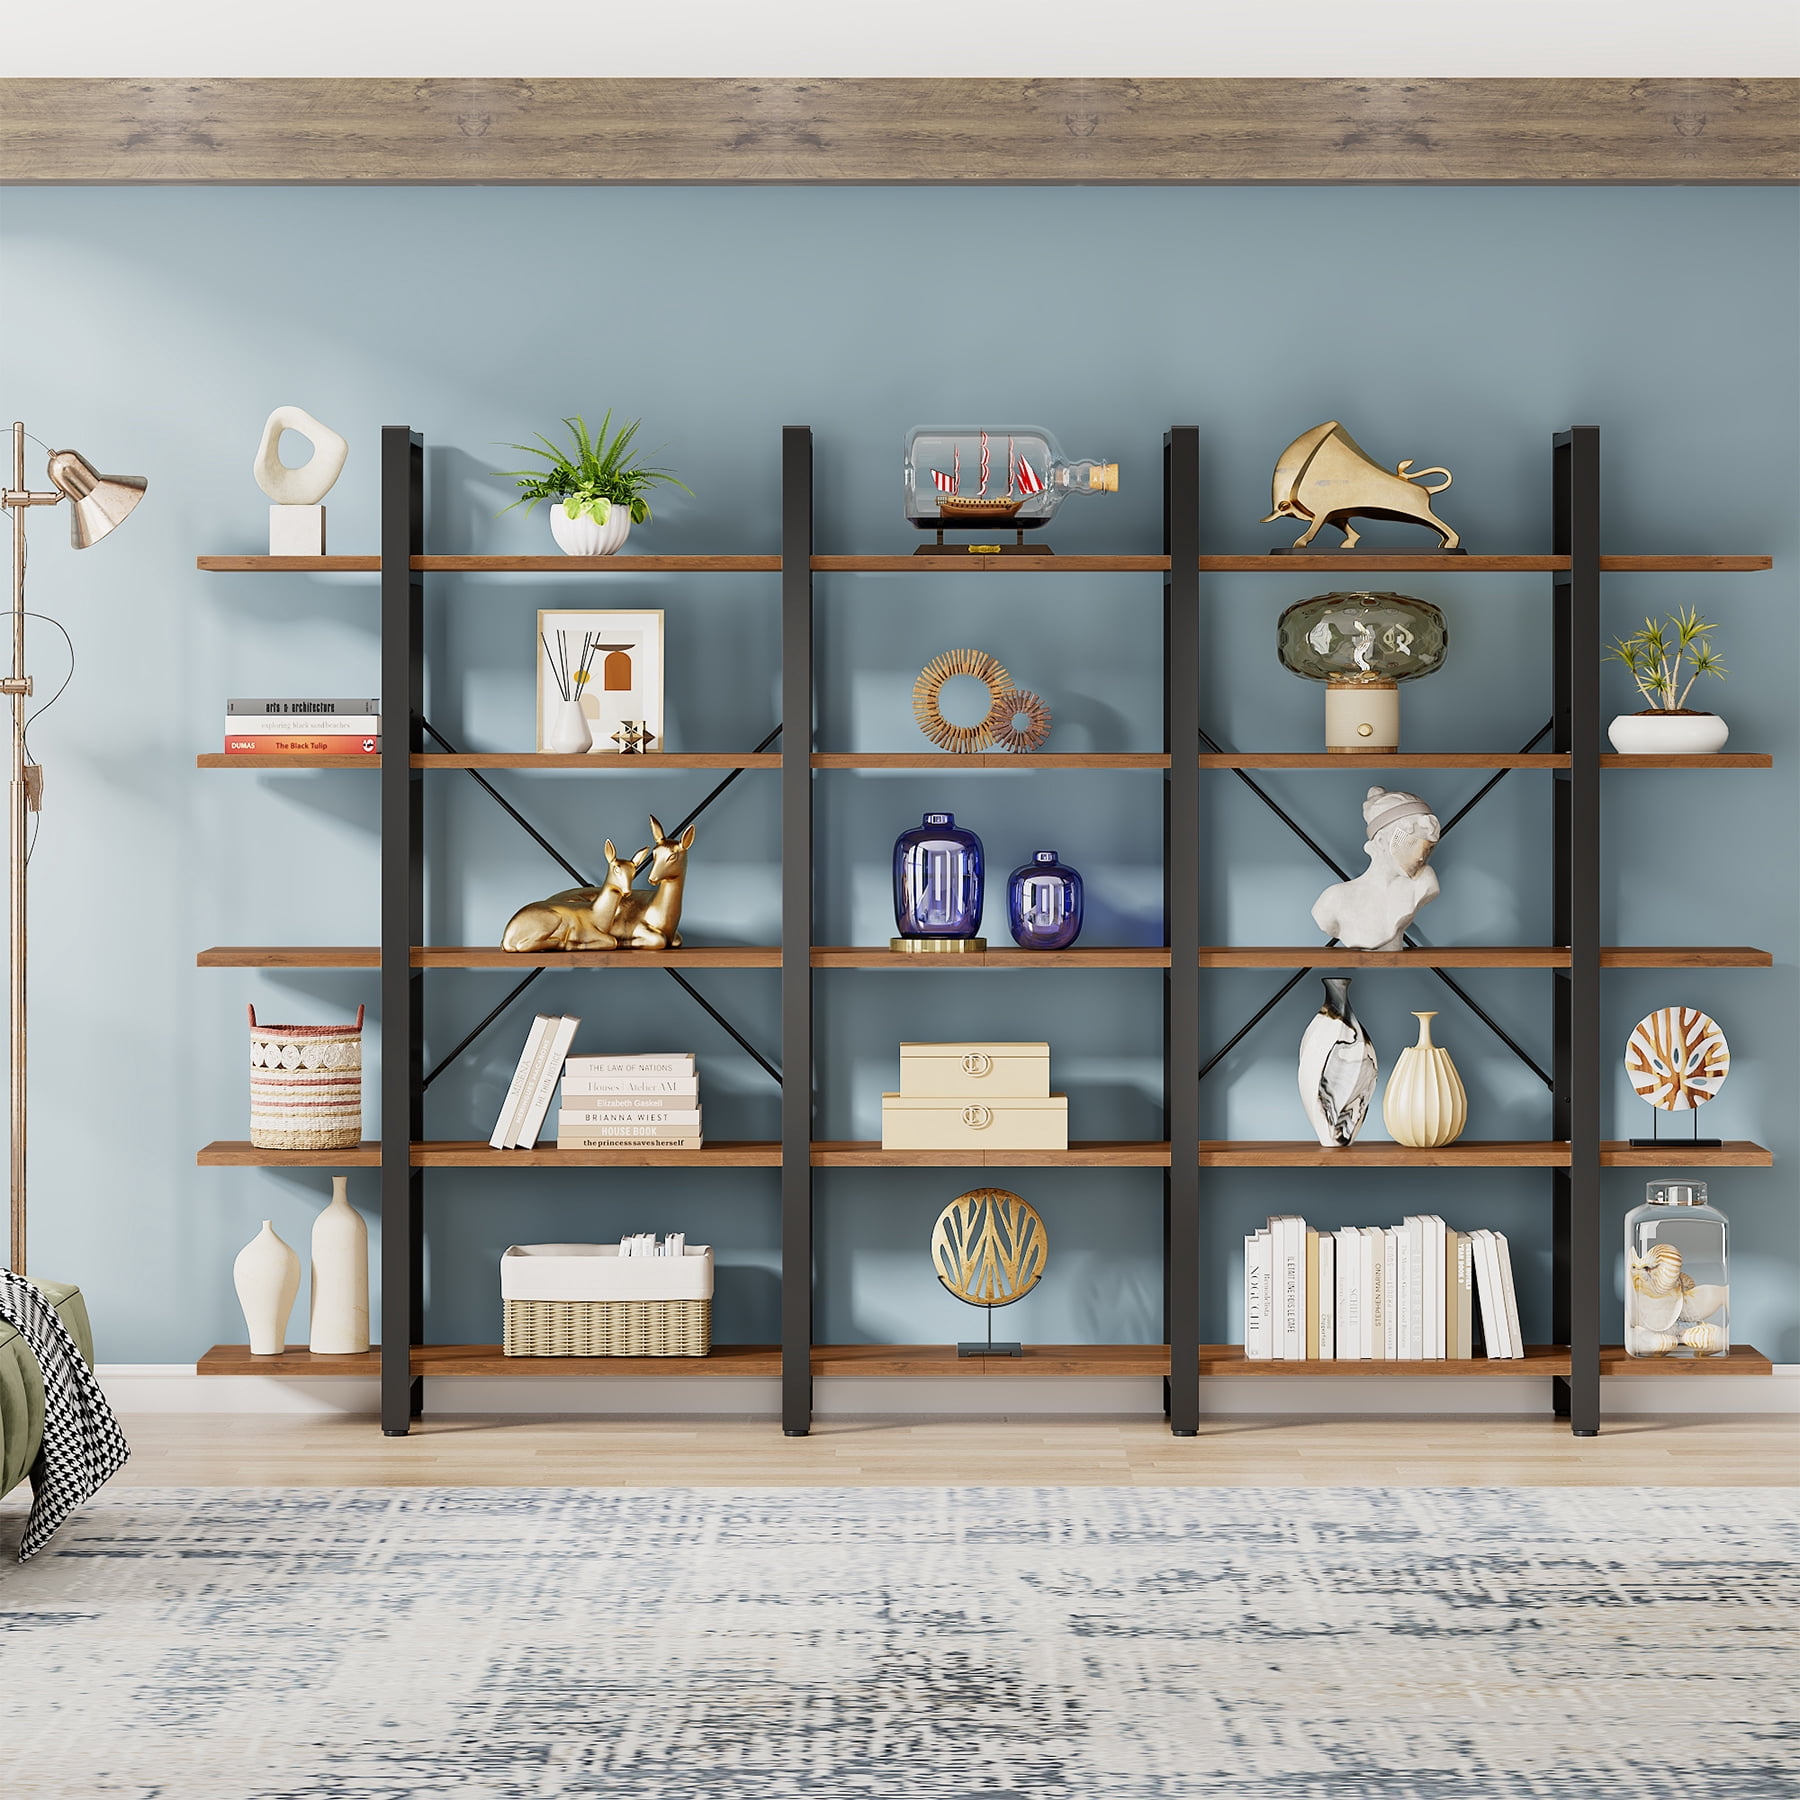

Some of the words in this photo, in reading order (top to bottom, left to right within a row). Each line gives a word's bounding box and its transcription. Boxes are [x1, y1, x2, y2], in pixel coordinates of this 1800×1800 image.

[266, 702, 280, 713] arts
[292, 701, 335, 713] architecture
[231, 741, 256, 750] DUMAS
[275, 742, 289, 750] The
[290, 742, 309, 750] Black
[311, 742, 328, 751] Tulip
[589, 1064, 605, 1072] THE
[607, 1064, 624, 1072] LAW
[626, 1064, 637, 1072] OF
[639, 1064, 673, 1072] NATIONS
[596, 1099, 633, 1108] Elizabeth
[634, 1099, 663, 1108] Gaskell
[585, 1113, 633, 1122] BRIANNA
[637, 1113, 669, 1122] WIEST
[601, 1127, 632, 1137] HOUSE
[633, 1127, 658, 1137] BOOK
